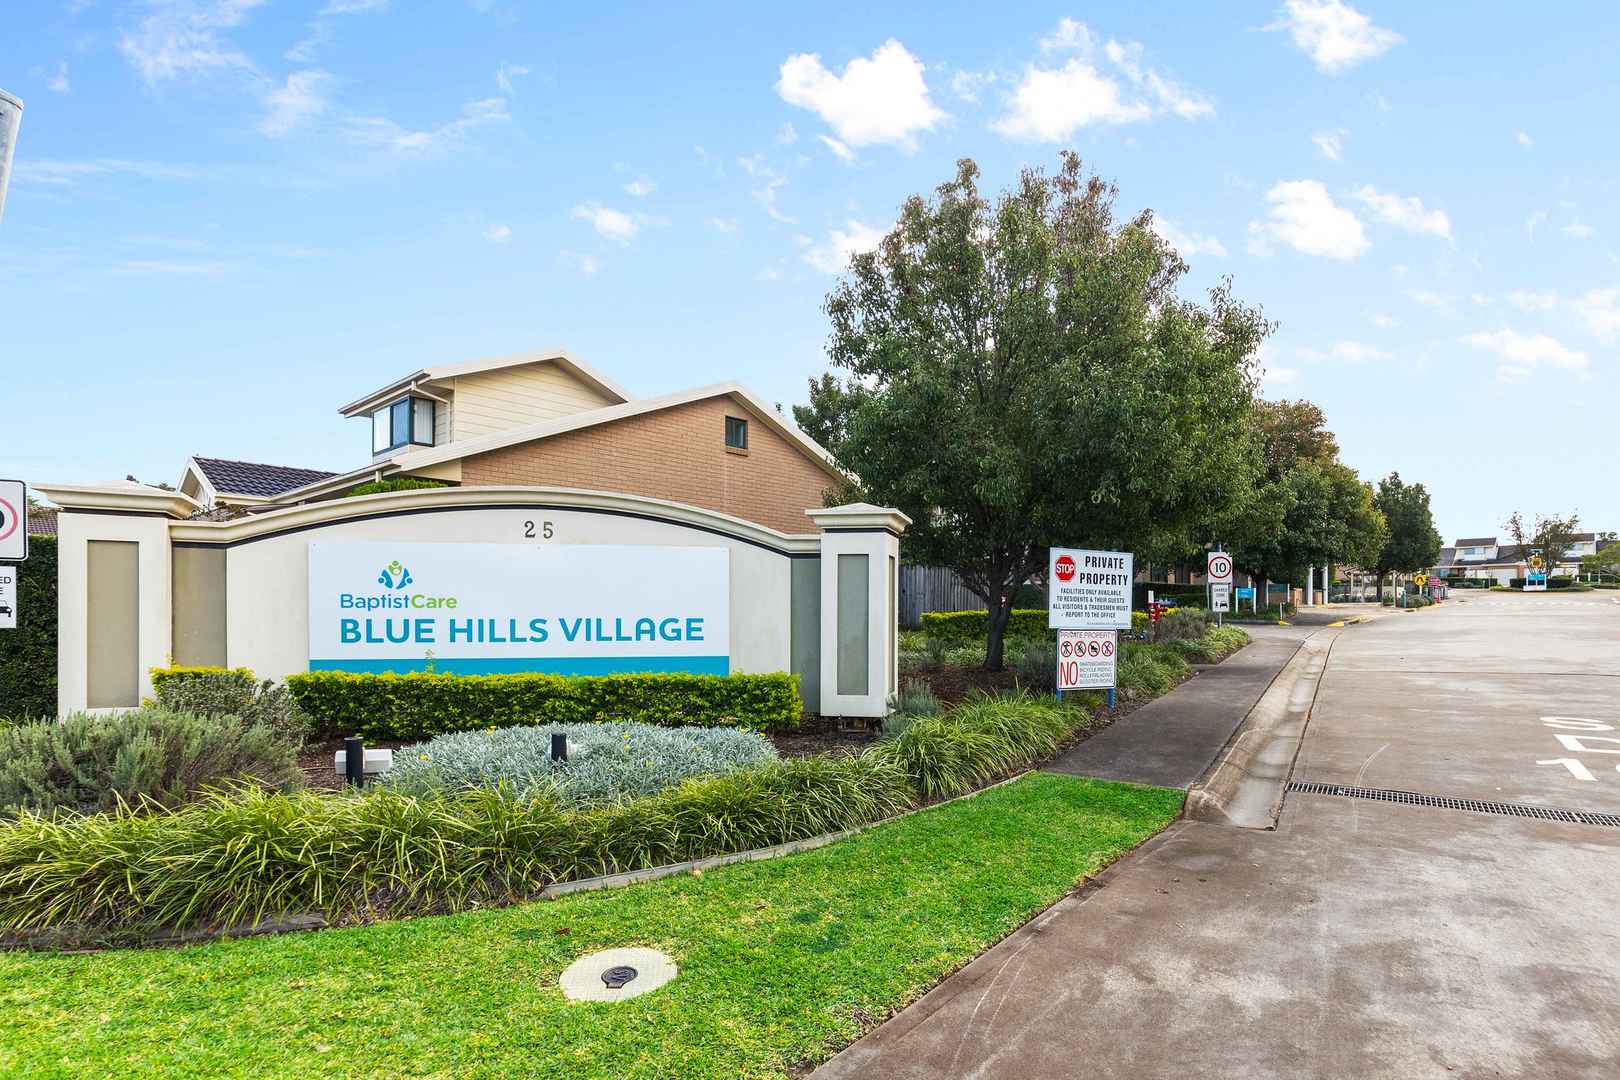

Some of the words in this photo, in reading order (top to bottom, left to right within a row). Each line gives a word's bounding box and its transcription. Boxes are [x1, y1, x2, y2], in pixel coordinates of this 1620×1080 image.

[524, 521, 554, 539] 25
[1056, 563, 1075, 574] STOP
[1085, 556, 1124, 570] PRIVATE
[1215, 562, 1227, 573] 10
[1079, 572, 1128, 586] PROPERTY
[1060, 587, 1085, 595] FACILITIES
[340, 593, 457, 611] BaptistCare
[340, 618, 436, 643] BLUE
[449, 618, 549, 643] HILLS
[558, 617, 705, 642] VILLAGE
[1060, 661, 1078, 686] NO
